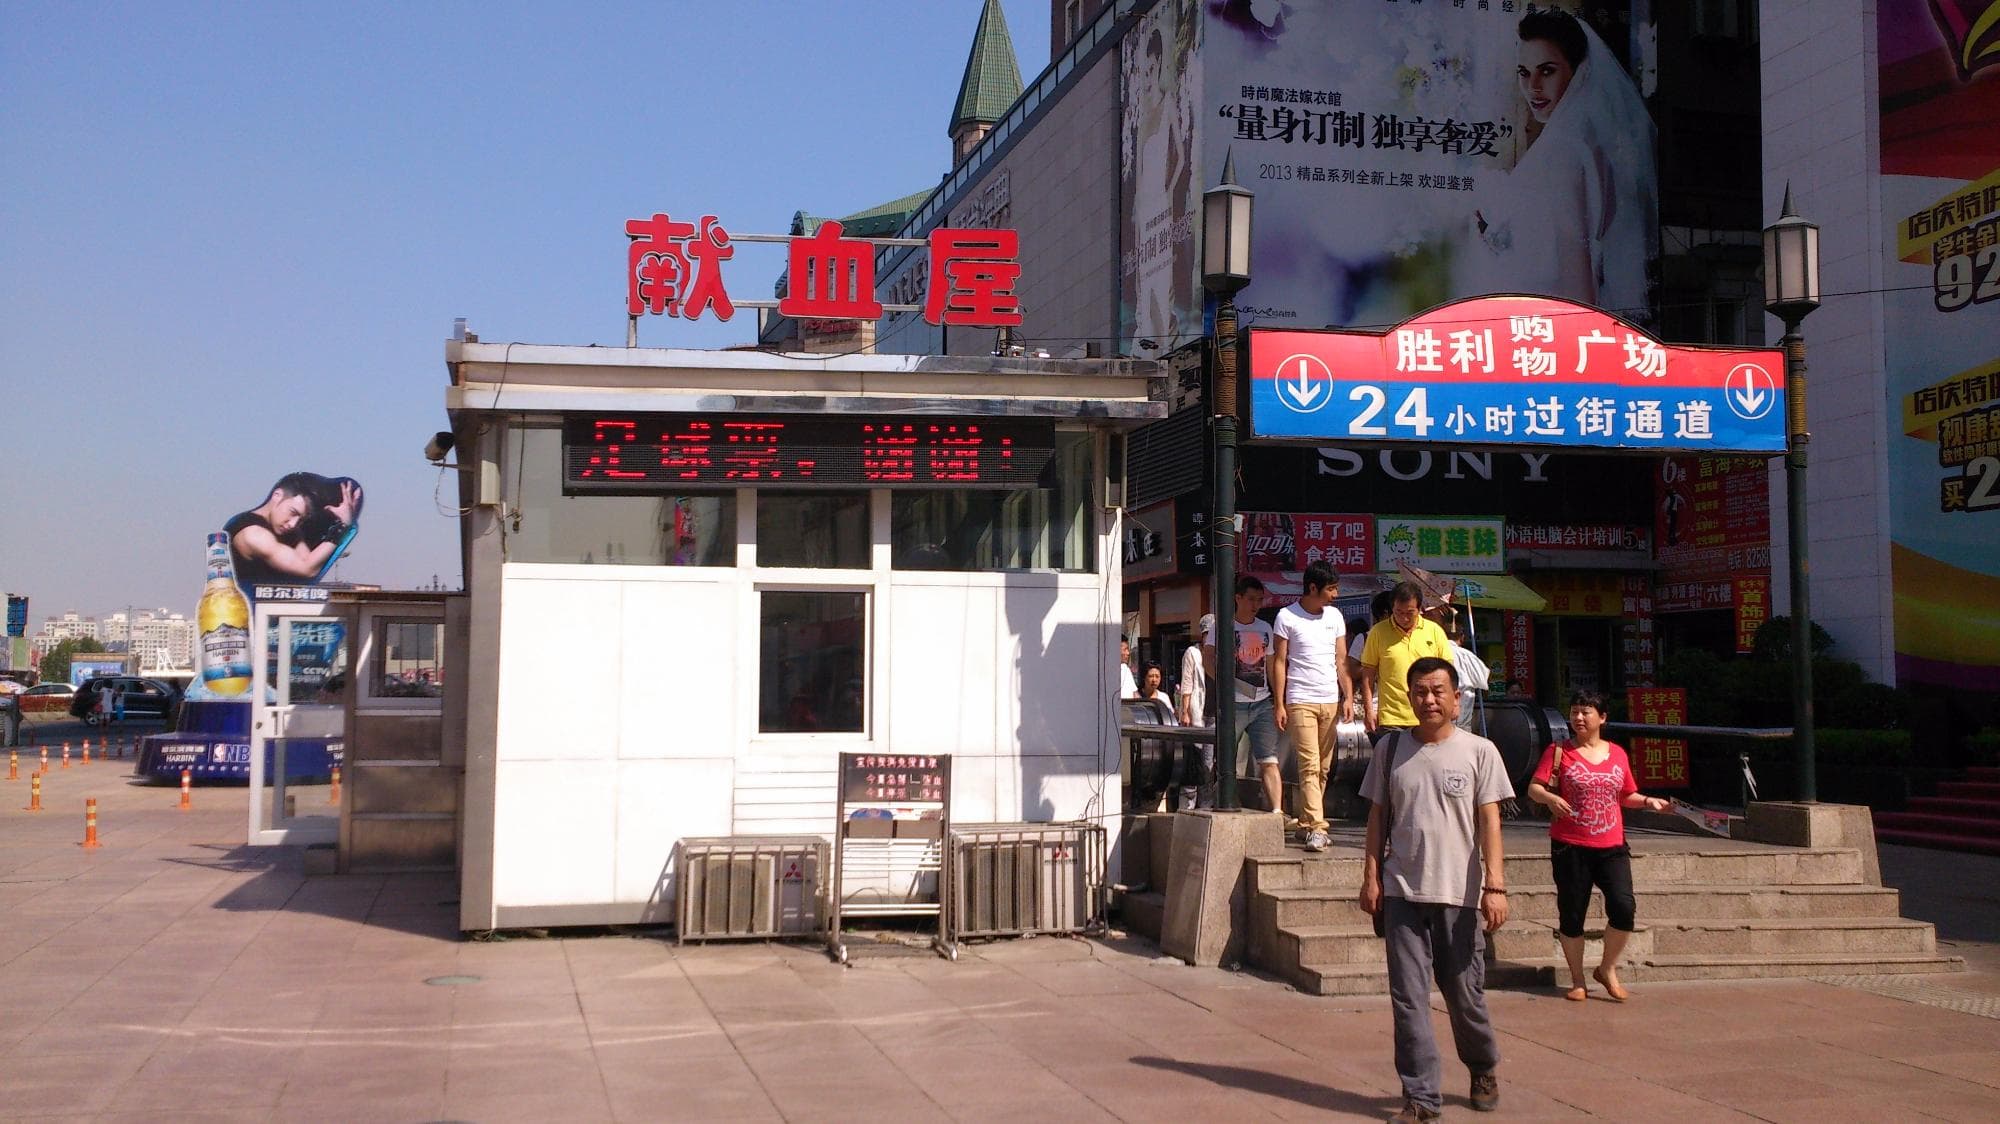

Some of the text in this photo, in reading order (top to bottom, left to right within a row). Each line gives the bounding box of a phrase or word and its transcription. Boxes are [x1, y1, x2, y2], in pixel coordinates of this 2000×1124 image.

[1241, 85, 1341, 107] 時尚魔法嫁衣館
[1259, 163, 1475, 192] 2013 精品系列全新上架 欢迎鉴赏
[625, 213, 1024, 327] 献血屋
[1396, 314, 1667, 378] 胜利购物广场
[1348, 384, 1714, 440] 24小时过街通道
[1318, 448, 1549, 482] SONY
[1303, 520, 1366, 541] 渴了吧
[1506, 525, 1622, 547] 外语电脑会计培训
[1303, 545, 1366, 567] 食杂店
[1641, 691, 1682, 706] 老字号
[166, 754, 195, 763] HARBIN
